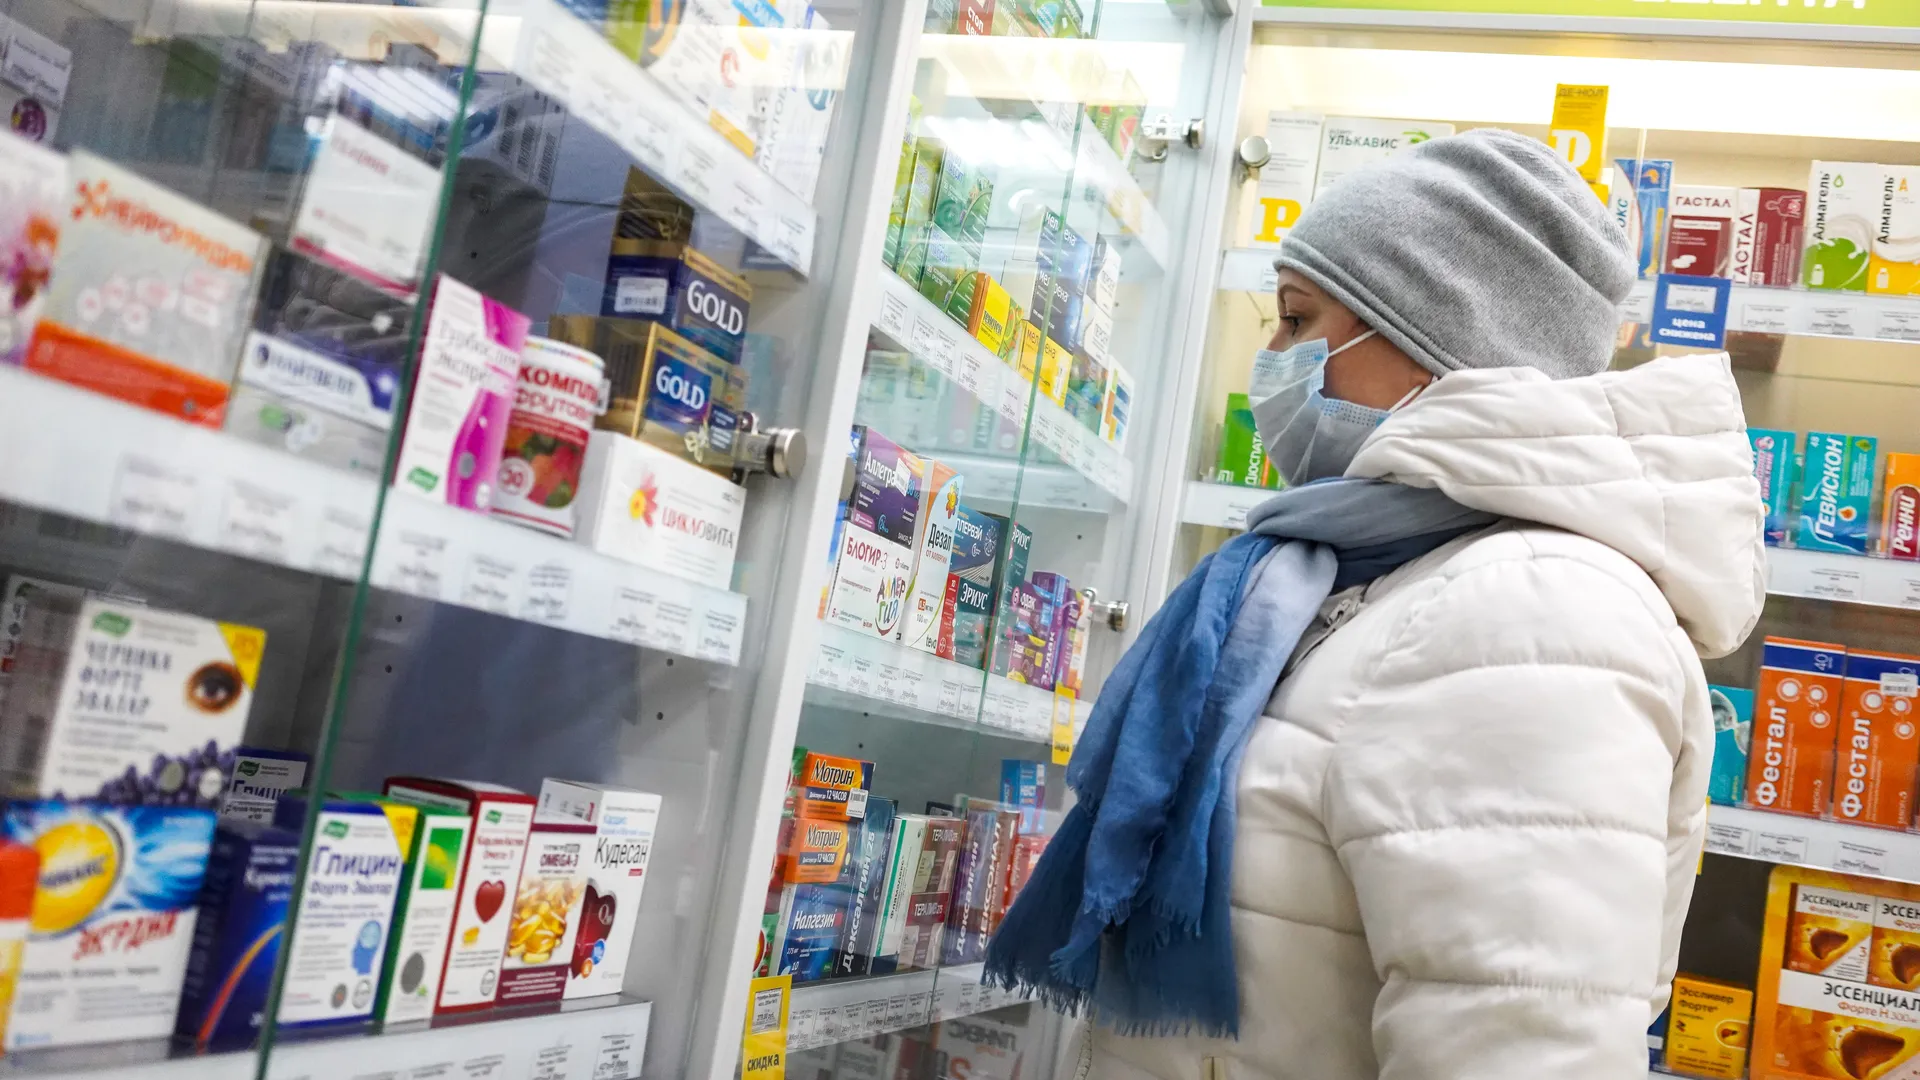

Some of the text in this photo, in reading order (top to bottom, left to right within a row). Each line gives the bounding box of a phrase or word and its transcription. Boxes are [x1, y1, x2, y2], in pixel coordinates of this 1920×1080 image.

[1328, 134, 1399, 149] УЛЬКАВИС
[1675, 196, 1732, 209] ГАСТАЛ
[1813, 173, 1831, 241] Алмагель
[1877, 177, 1896, 245] Алмагель
[1732, 213, 1754, 285] ГАСТАЛ
[687, 280, 744, 336] GOLD
[1672, 318, 1706, 329] цена
[1659, 328, 1716, 342] снижена
[655, 365, 706, 410] GOLD
[1815, 437, 1844, 539] ГЕВИСКОН
[662, 506, 736, 550] ЦИКЛОВИТА
[928, 523, 952, 552] Дезал
[1892, 494, 1917, 554] Ренни
[846, 536, 889, 571] БЛОГИР-3
[960, 582, 989, 612] ЭРИУС
[1755, 706, 1788, 807] Фестал
[1840, 717, 1872, 818] Фестал
[811, 759, 856, 787] Мотрин
[804, 824, 842, 850] Мотрин
[311, 846, 399, 879] Глицин
[594, 838, 650, 870] Кудесан
[842, 855, 872, 974] Дексалгин
[1801, 893, 1872, 913] ЭССЕНЦИАЛЕ
[792, 910, 836, 931] Налгезин
[1679, 985, 1735, 1005] Эссливер
[1837, 1001, 1878, 1016] Форте
[747, 1054, 780, 1072] скидка
